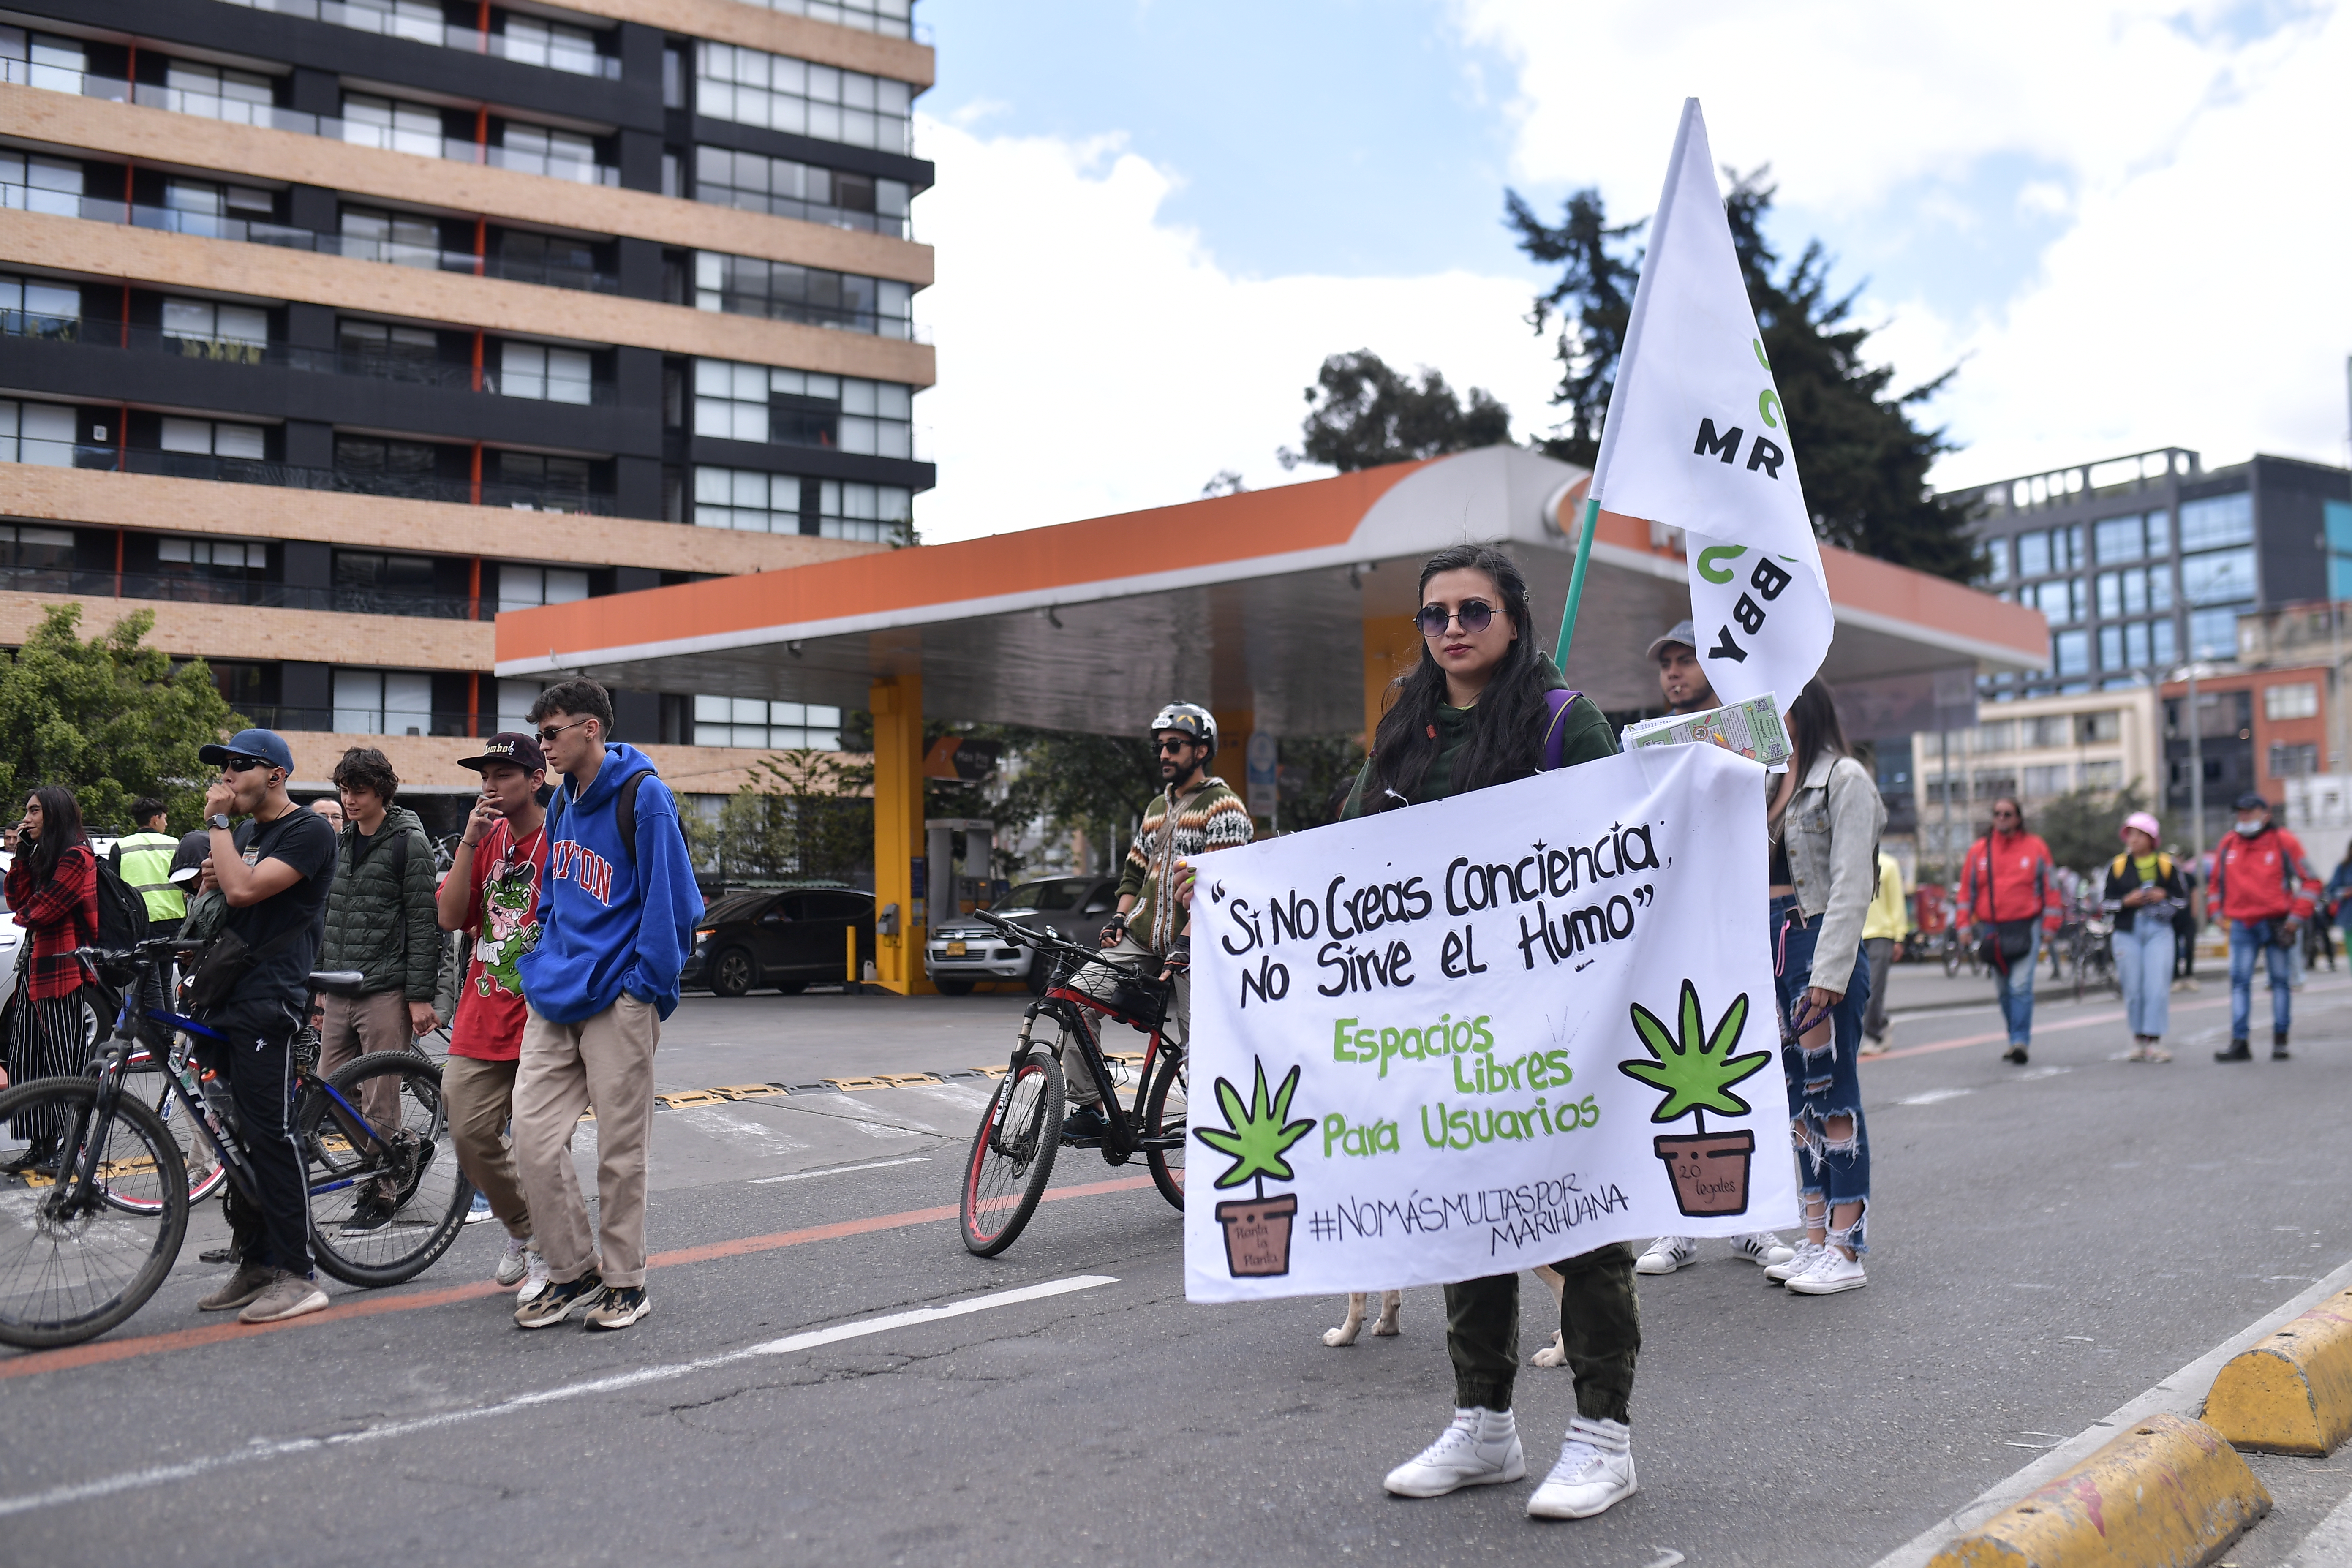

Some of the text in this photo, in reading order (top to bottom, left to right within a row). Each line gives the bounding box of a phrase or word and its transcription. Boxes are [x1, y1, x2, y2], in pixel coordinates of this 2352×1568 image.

[1693, 418, 1784, 481] MR
[1326, 876, 1432, 940] Creas
[1317, 941, 1415, 996] Sirve
[1334, 1013, 1494, 1078] Espacios
[1454, 1049, 1573, 1094] Libres
[1324, 1095, 1600, 1157] Para Usuarios
[1696, 1176, 1736, 1204] legales
[424, 1217, 459, 1260] MAXXIS
[1236, 1223, 1268, 1239] Planta
[1492, 1183, 1629, 1257] MARIHUANA
[1244, 1251, 1277, 1267] Planta
